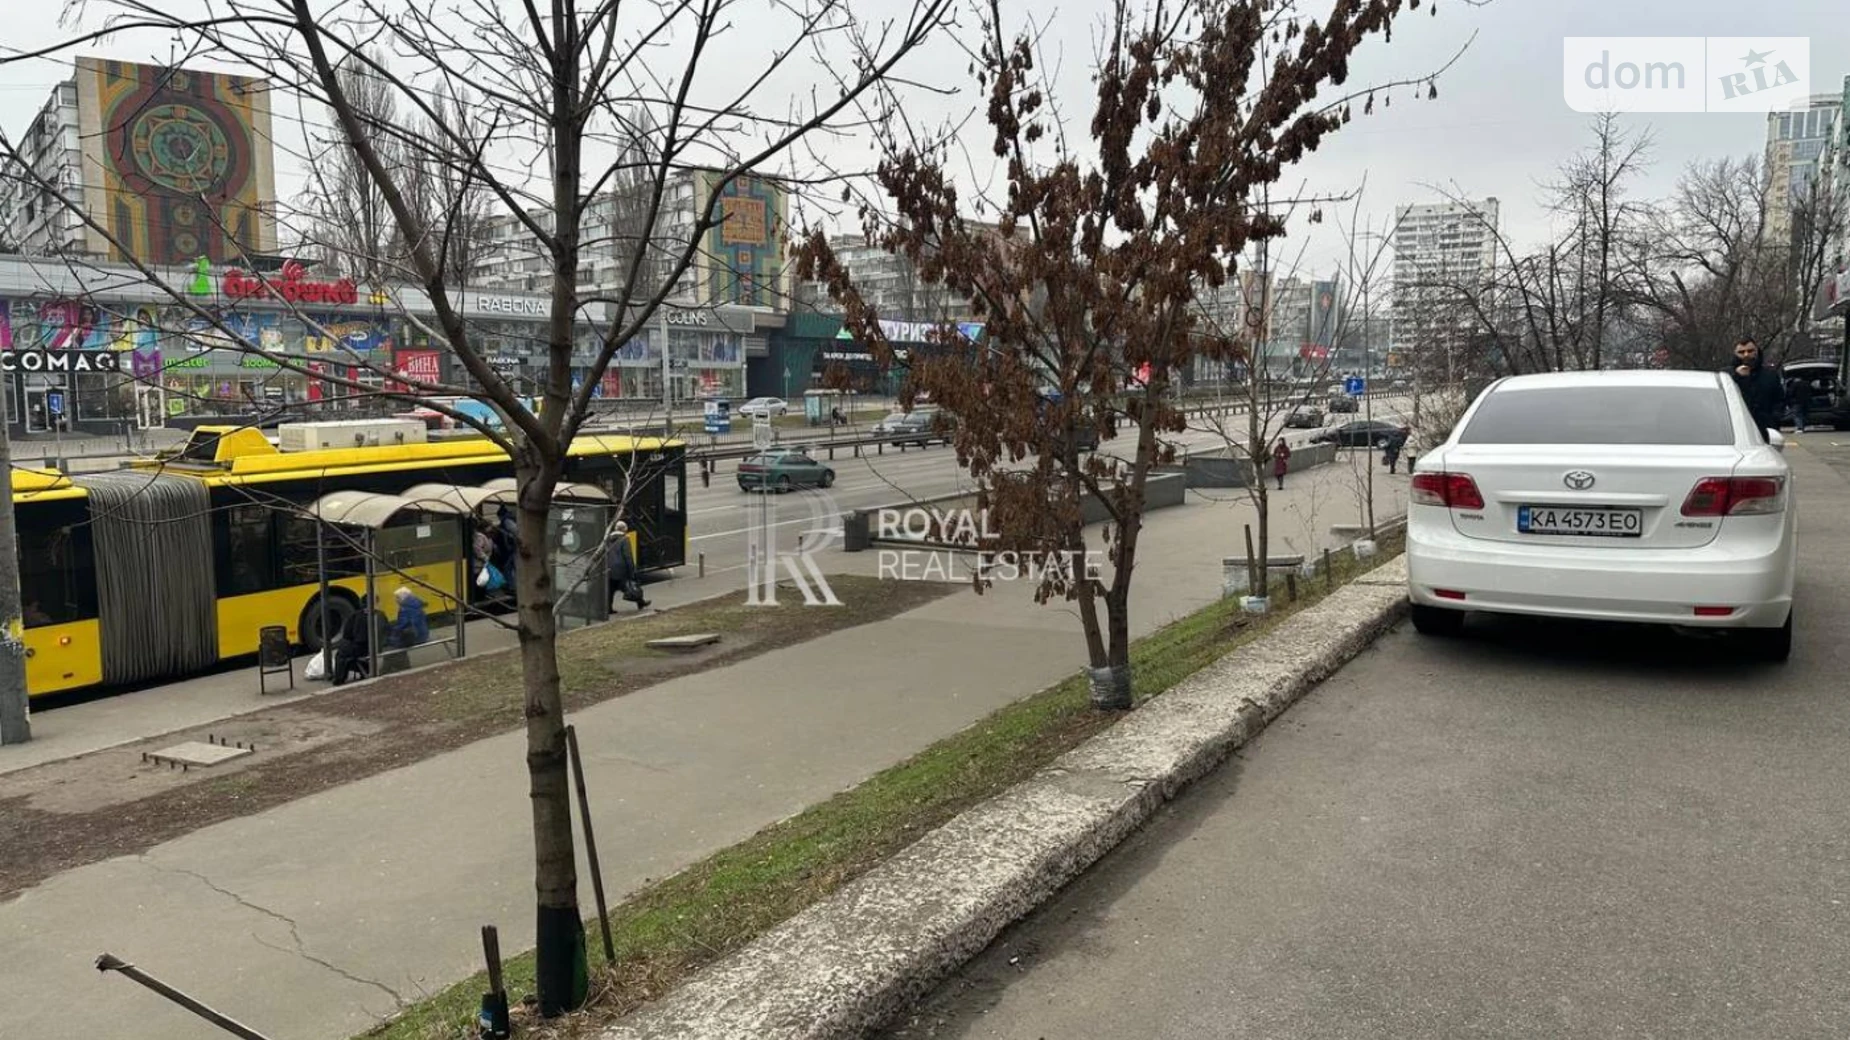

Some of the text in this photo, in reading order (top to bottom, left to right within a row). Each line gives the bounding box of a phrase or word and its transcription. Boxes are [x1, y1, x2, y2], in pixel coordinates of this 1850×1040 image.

[478, 297, 546, 315] RABONA
[408, 355, 439, 372] ВИНА
[1530, 510, 1558, 528] KA
[1561, 511, 1605, 529] 4573
[1609, 512, 1638, 531] EO
